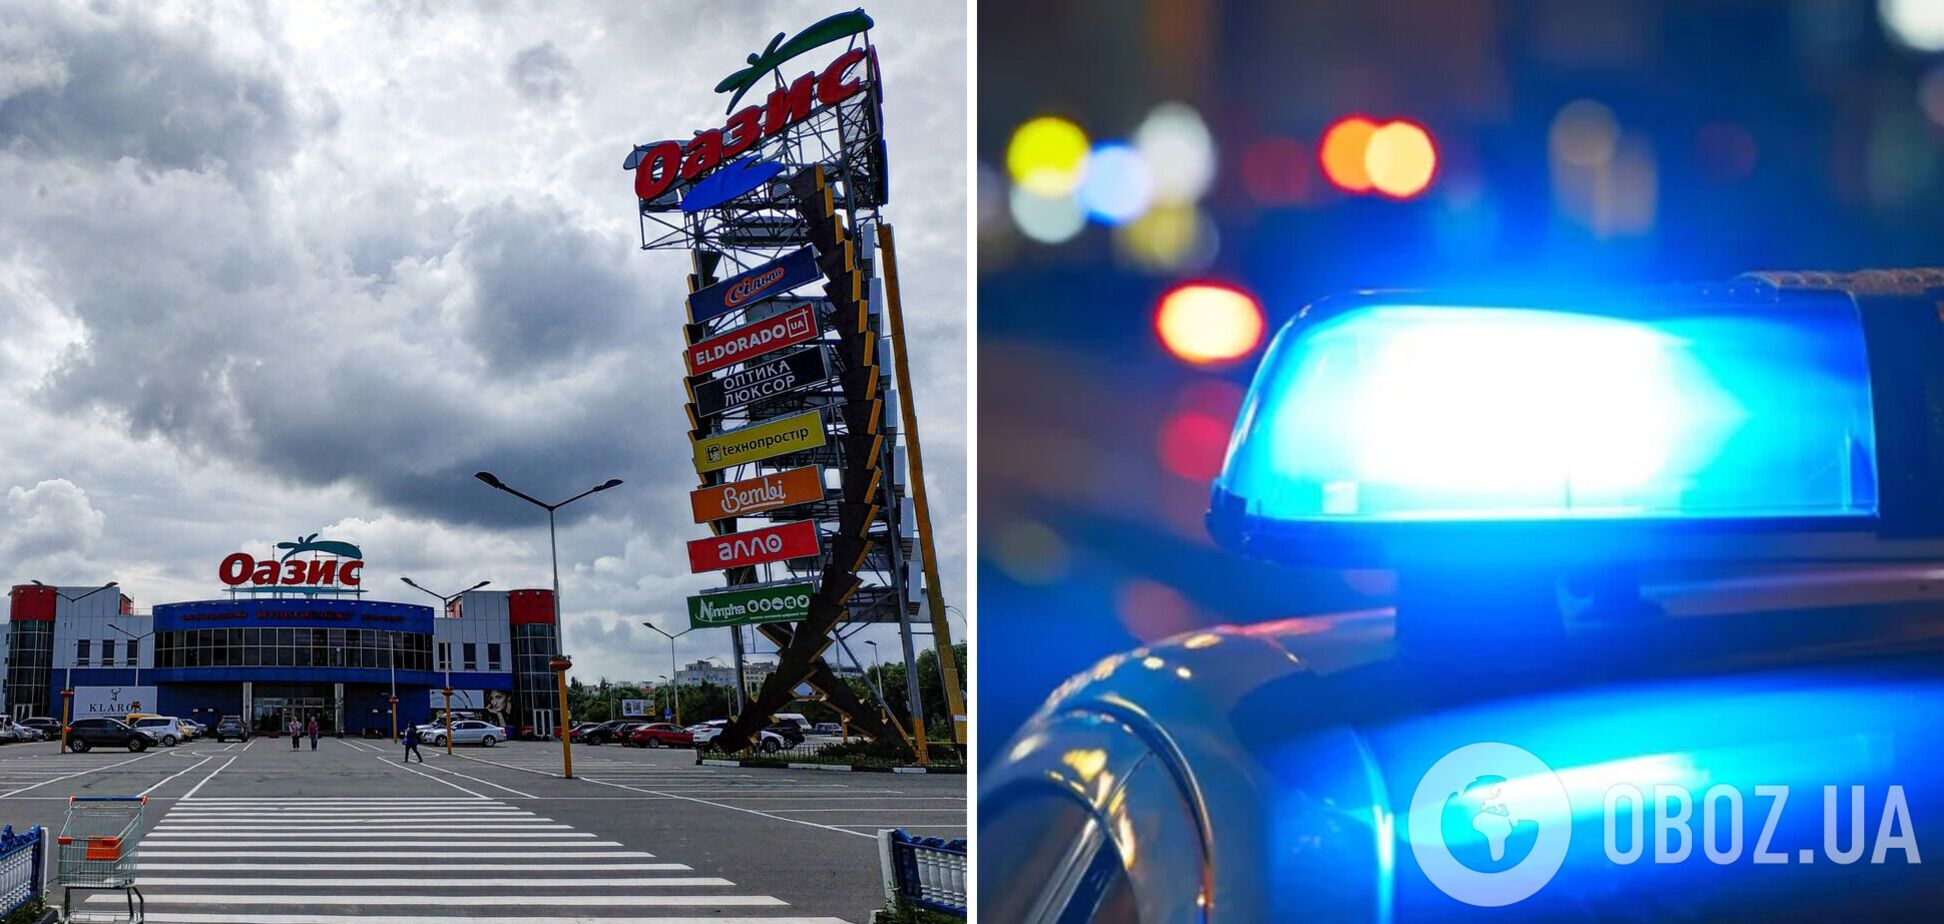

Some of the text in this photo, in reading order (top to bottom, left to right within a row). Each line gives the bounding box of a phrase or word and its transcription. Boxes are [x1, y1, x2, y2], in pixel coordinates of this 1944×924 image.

[634, 47, 867, 199] Оазис
[696, 320, 804, 365] ELDORADO UA
[724, 360, 791, 390] ОПТИКА
[724, 375, 796, 406] ЛЮКСОР
[721, 477, 786, 513] Bembi
[219, 553, 364, 585] Оазис
[700, 598, 746, 622] Nimpha
